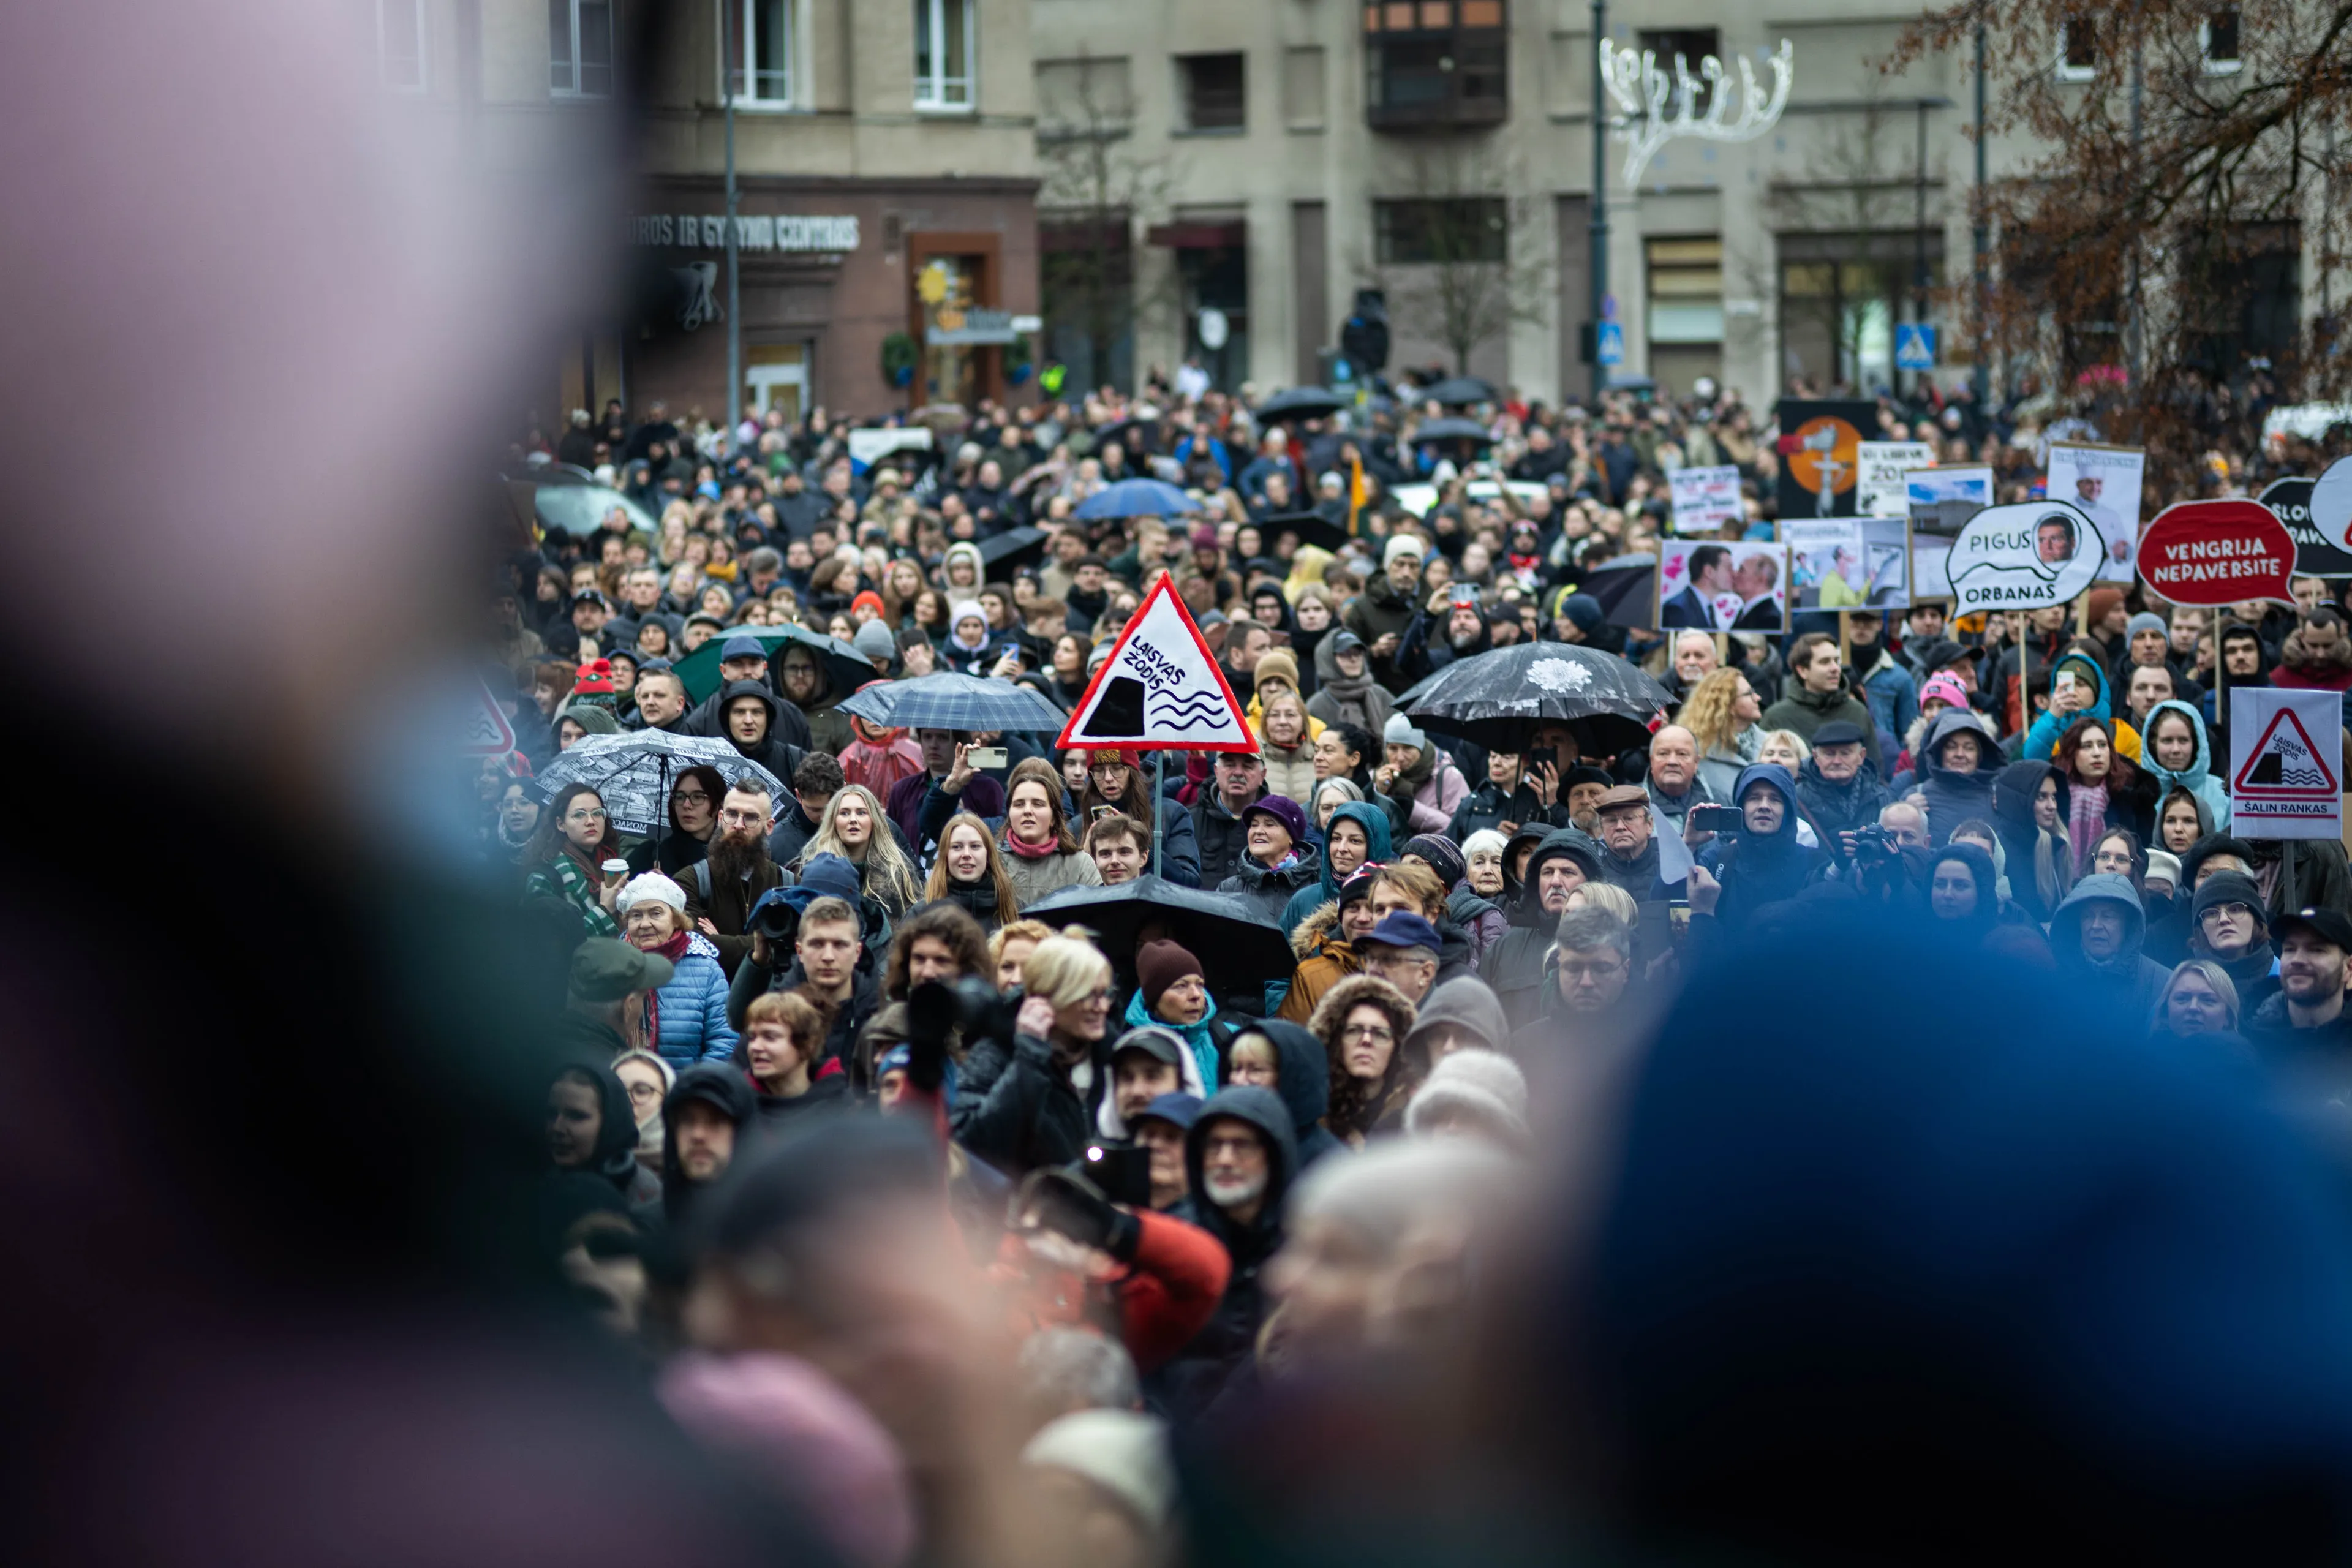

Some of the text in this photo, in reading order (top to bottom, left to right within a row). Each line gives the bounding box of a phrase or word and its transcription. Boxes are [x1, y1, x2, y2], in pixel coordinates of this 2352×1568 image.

[679, 215, 699, 246] IR
[1970, 530, 2031, 552] PIGUS
[2165, 537, 2266, 560] VENGRIJA
[2154, 557, 2281, 583] NEPAVERSITE
[1966, 584, 2056, 603] ORBANAS
[1123, 649, 1164, 690] ŽODIS
[1131, 635, 1186, 685] LAISVAS
[2272, 734, 2308, 756] LAISVAS
[2272, 742, 2300, 761] ŽODIS
[2244, 801, 2328, 813] ŠALIN RANKAS
